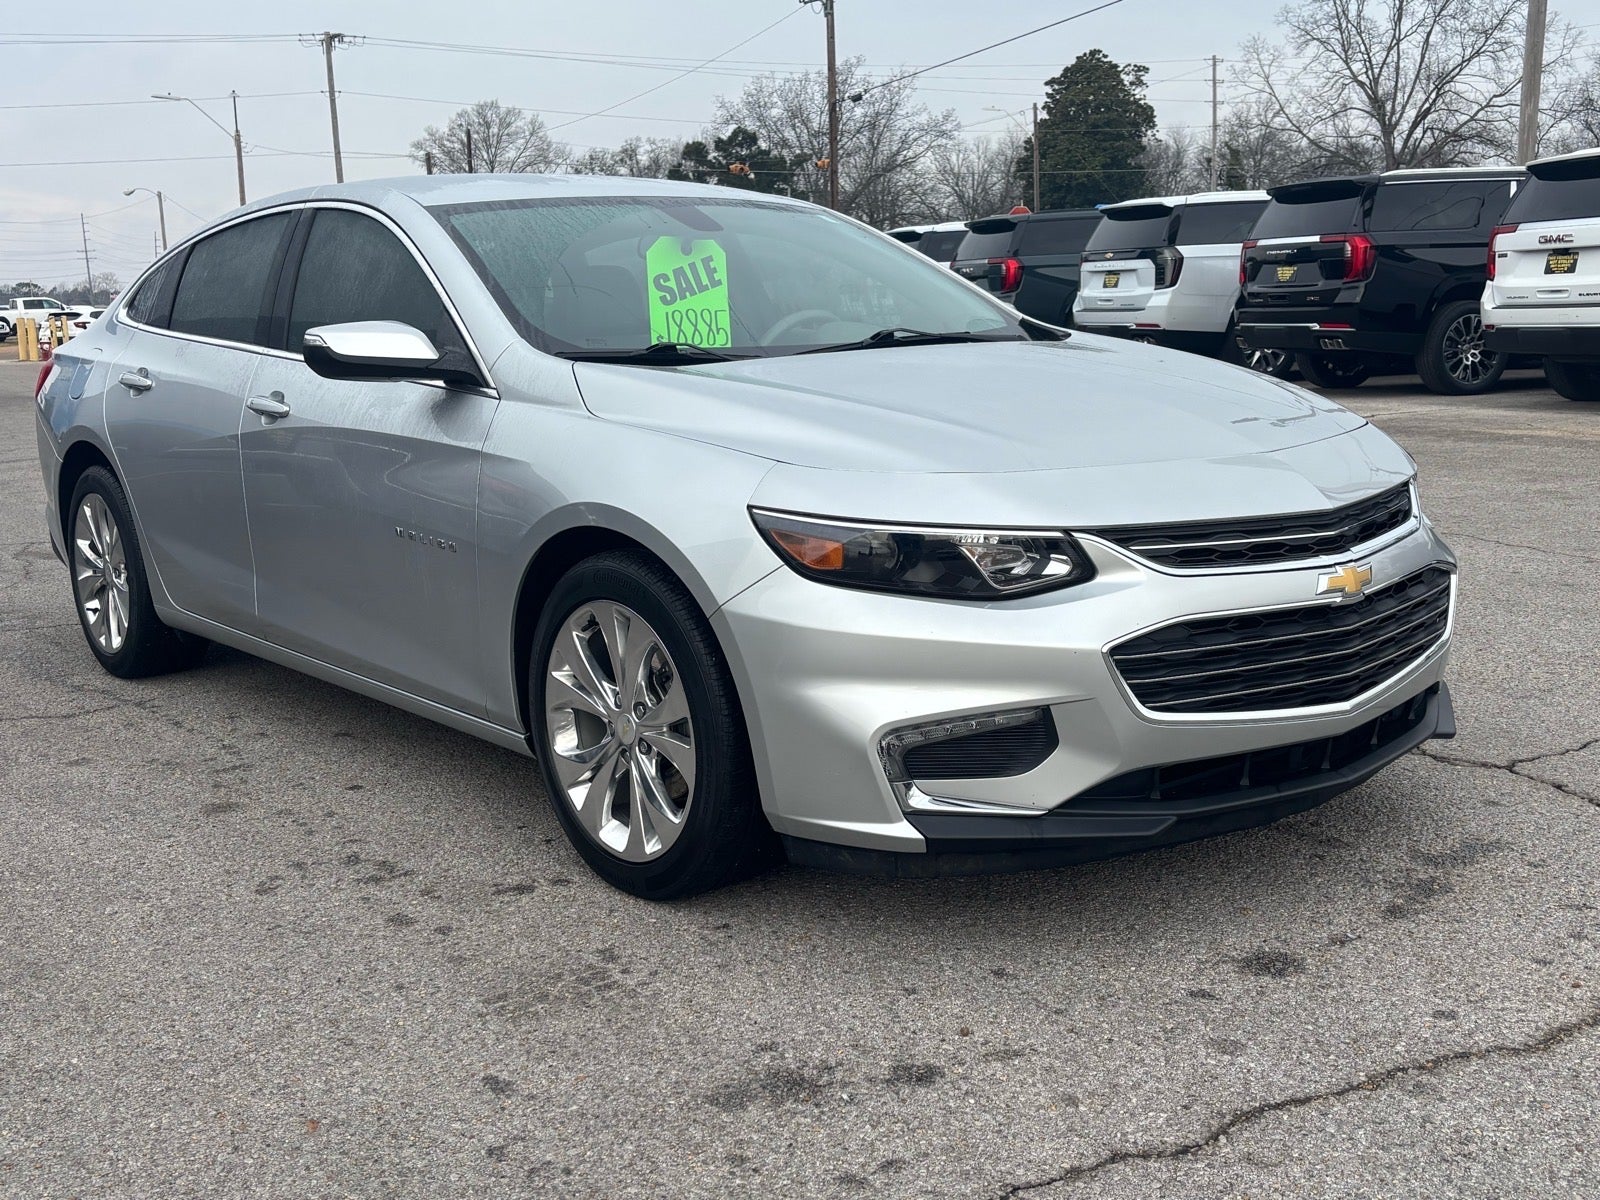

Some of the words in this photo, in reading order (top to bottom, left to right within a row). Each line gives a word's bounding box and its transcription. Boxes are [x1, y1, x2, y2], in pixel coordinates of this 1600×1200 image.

[1539, 234, 1574, 244] GMC
[652, 254, 723, 306] SALE
[395, 526, 456, 553] MALIBU
